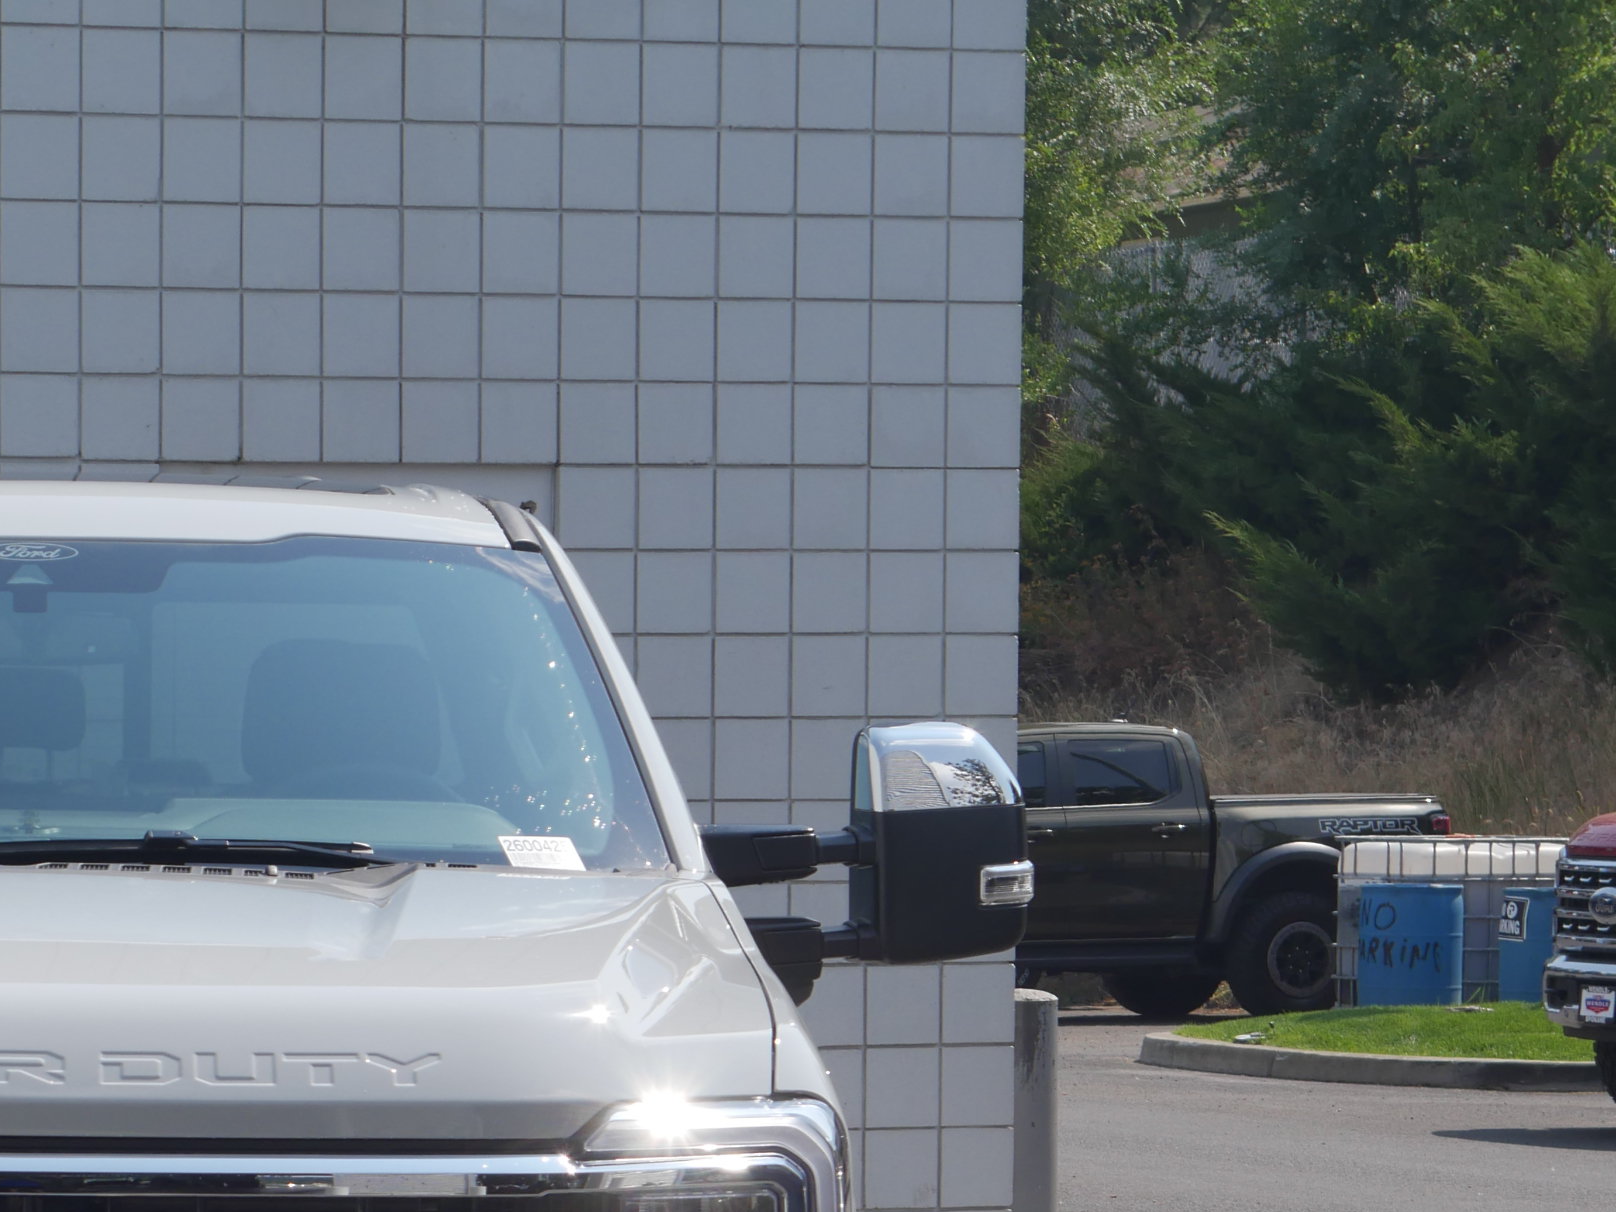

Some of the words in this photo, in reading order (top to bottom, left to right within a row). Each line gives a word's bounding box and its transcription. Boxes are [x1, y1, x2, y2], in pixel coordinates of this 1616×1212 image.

[0, 544, 61, 558] Ford
[1319, 818, 1422, 835] RAPTOR
[1362, 899, 1396, 931] NO
[99, 1051, 442, 1087] DUTY
